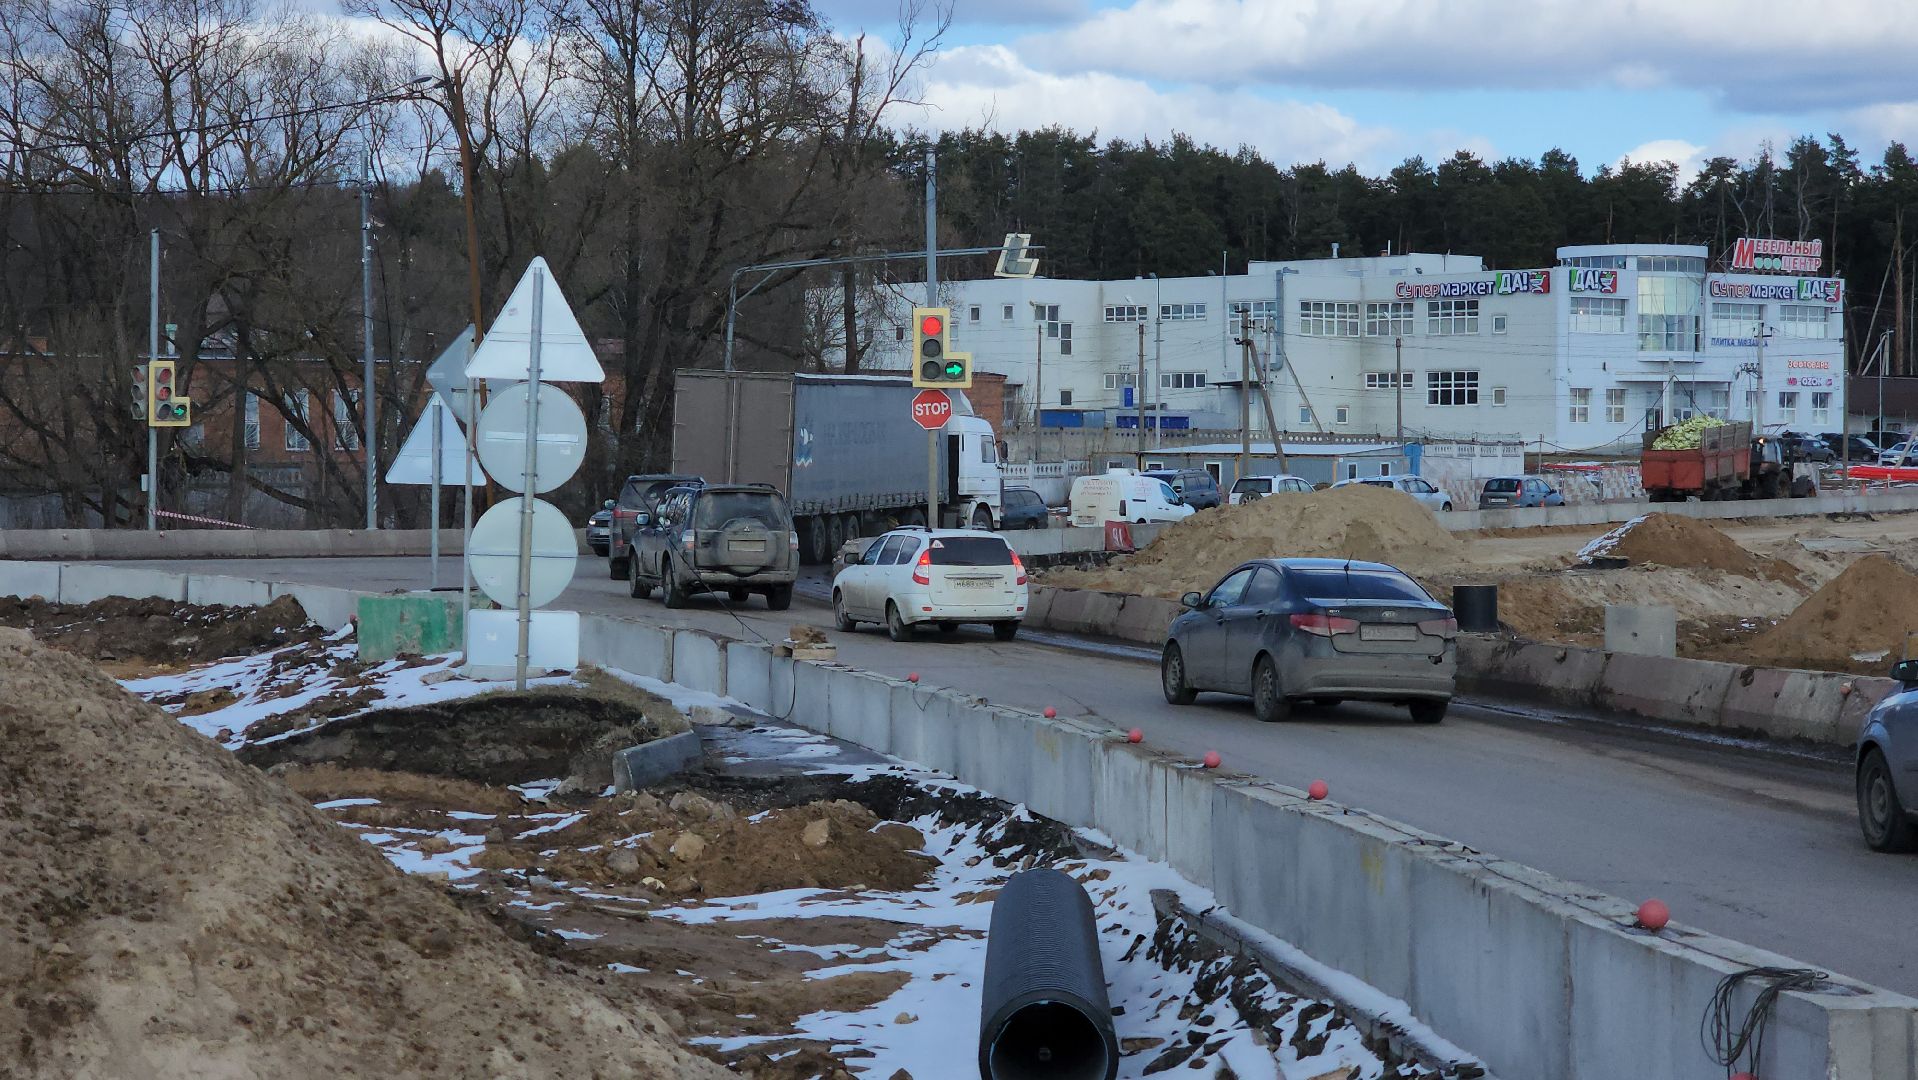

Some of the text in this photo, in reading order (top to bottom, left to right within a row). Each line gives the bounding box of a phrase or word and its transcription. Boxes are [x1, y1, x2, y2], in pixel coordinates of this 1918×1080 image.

[1781, 256, 1822, 273] ЦЕНТР
[1395, 271, 1529, 299] Супермаркет ДА!
[1572, 269, 1600, 292] ДА!
[1711, 279, 1825, 301] Супермаркет ДА!
[915, 402, 949, 417] STOP
